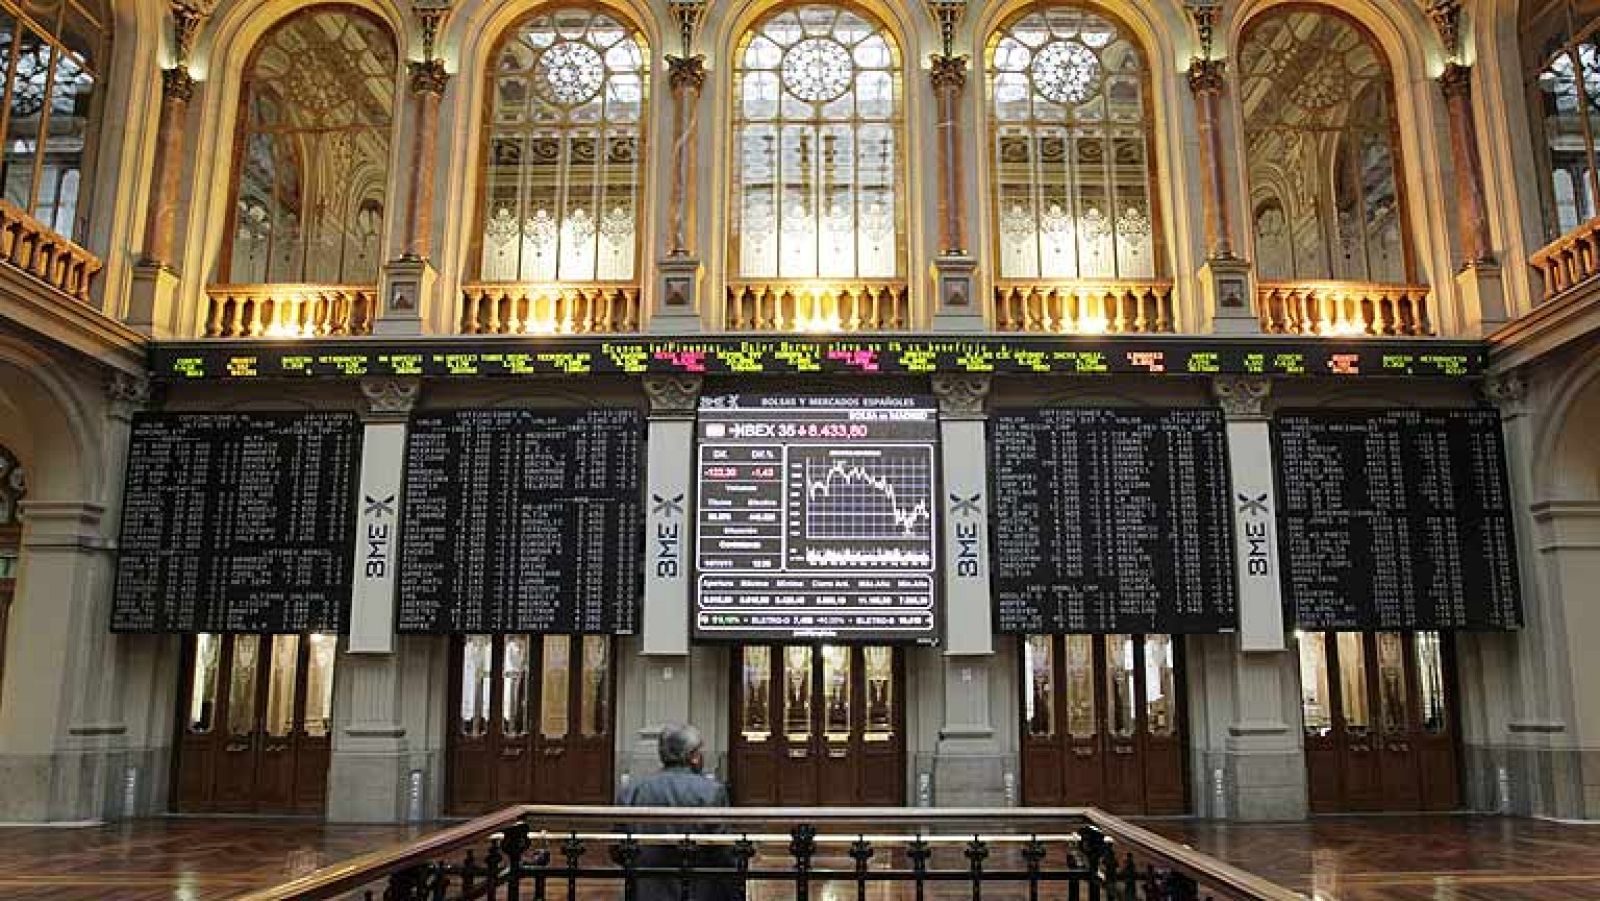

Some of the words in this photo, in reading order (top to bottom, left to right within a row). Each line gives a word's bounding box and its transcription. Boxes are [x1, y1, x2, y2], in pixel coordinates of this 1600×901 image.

[761, 397, 797, 406] BOLSAS
[809, 397, 859, 406] MERCADOS
[778, 425, 796, 437] 35
